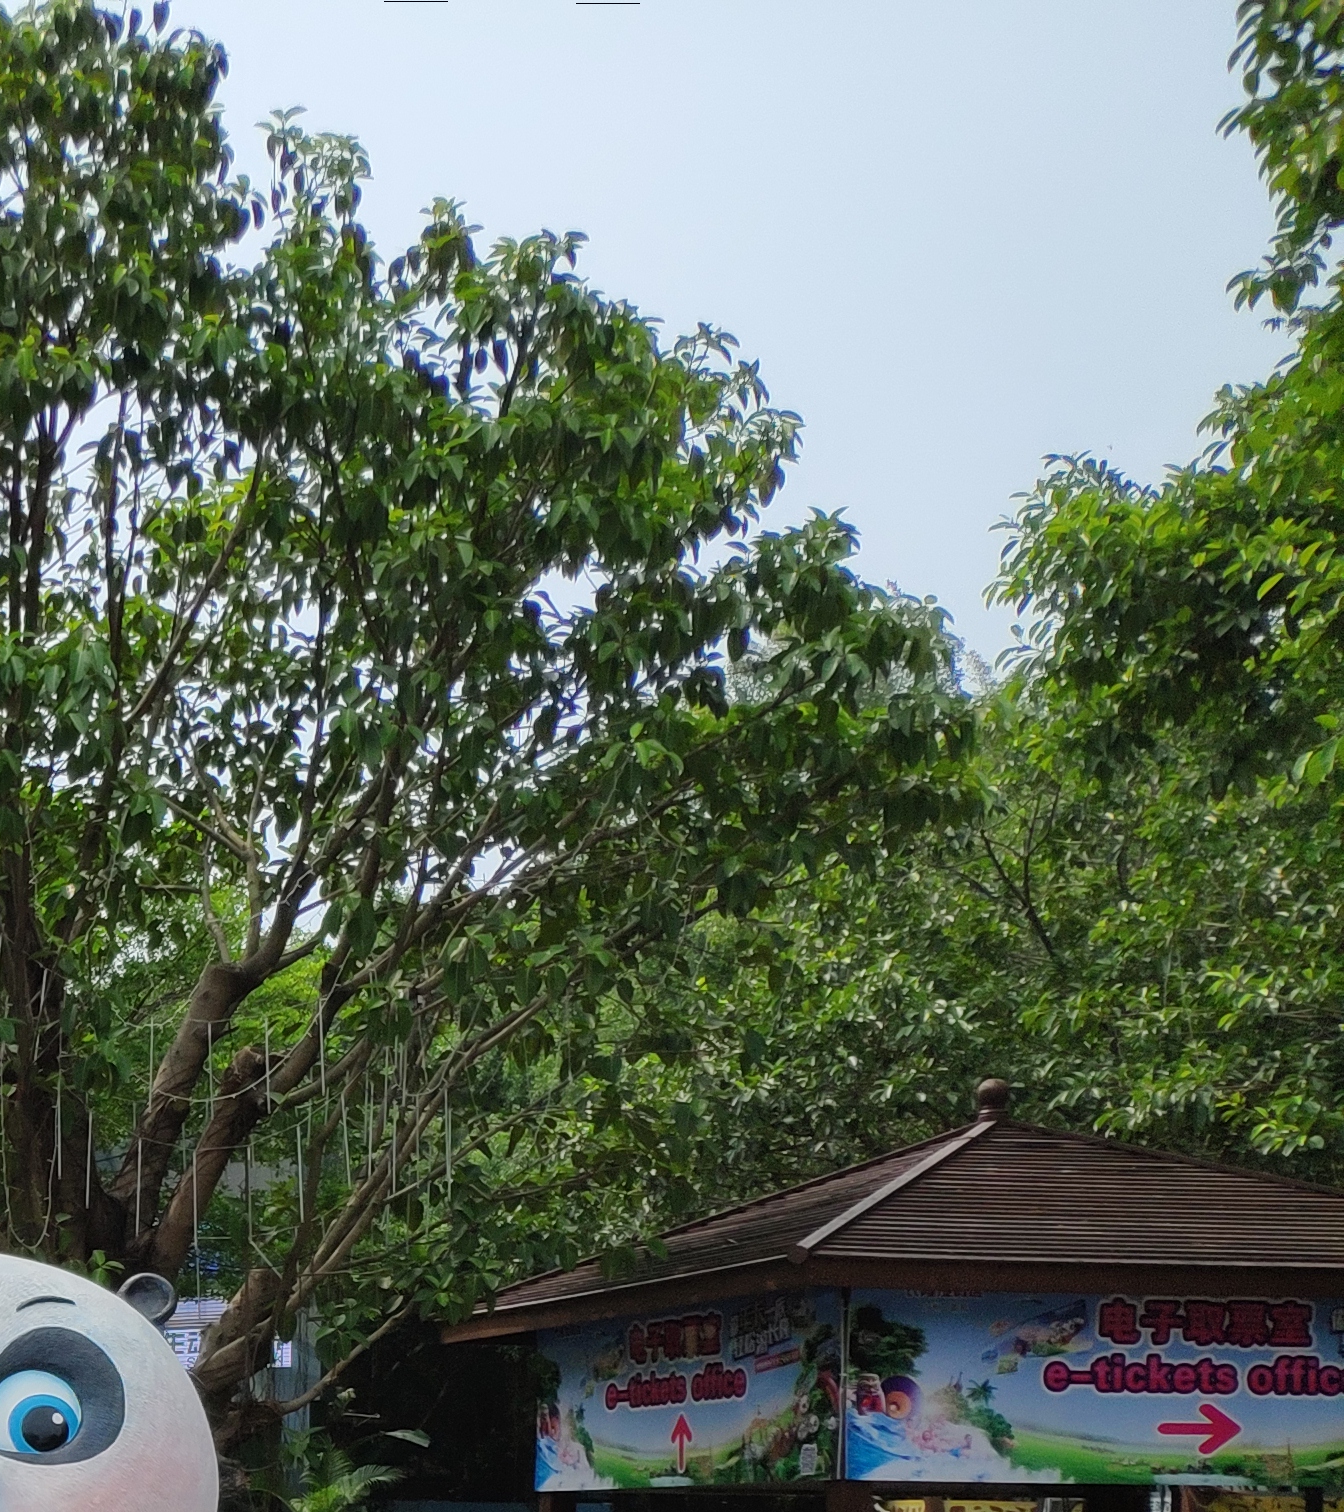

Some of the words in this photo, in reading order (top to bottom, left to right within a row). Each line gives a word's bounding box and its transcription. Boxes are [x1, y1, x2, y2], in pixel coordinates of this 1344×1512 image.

[605, 1370, 688, 1411] e-tickets
[691, 1362, 747, 1401] office
[1043, 1353, 1239, 1395] e-tickets
[1247, 1355, 1344, 1396] offic
